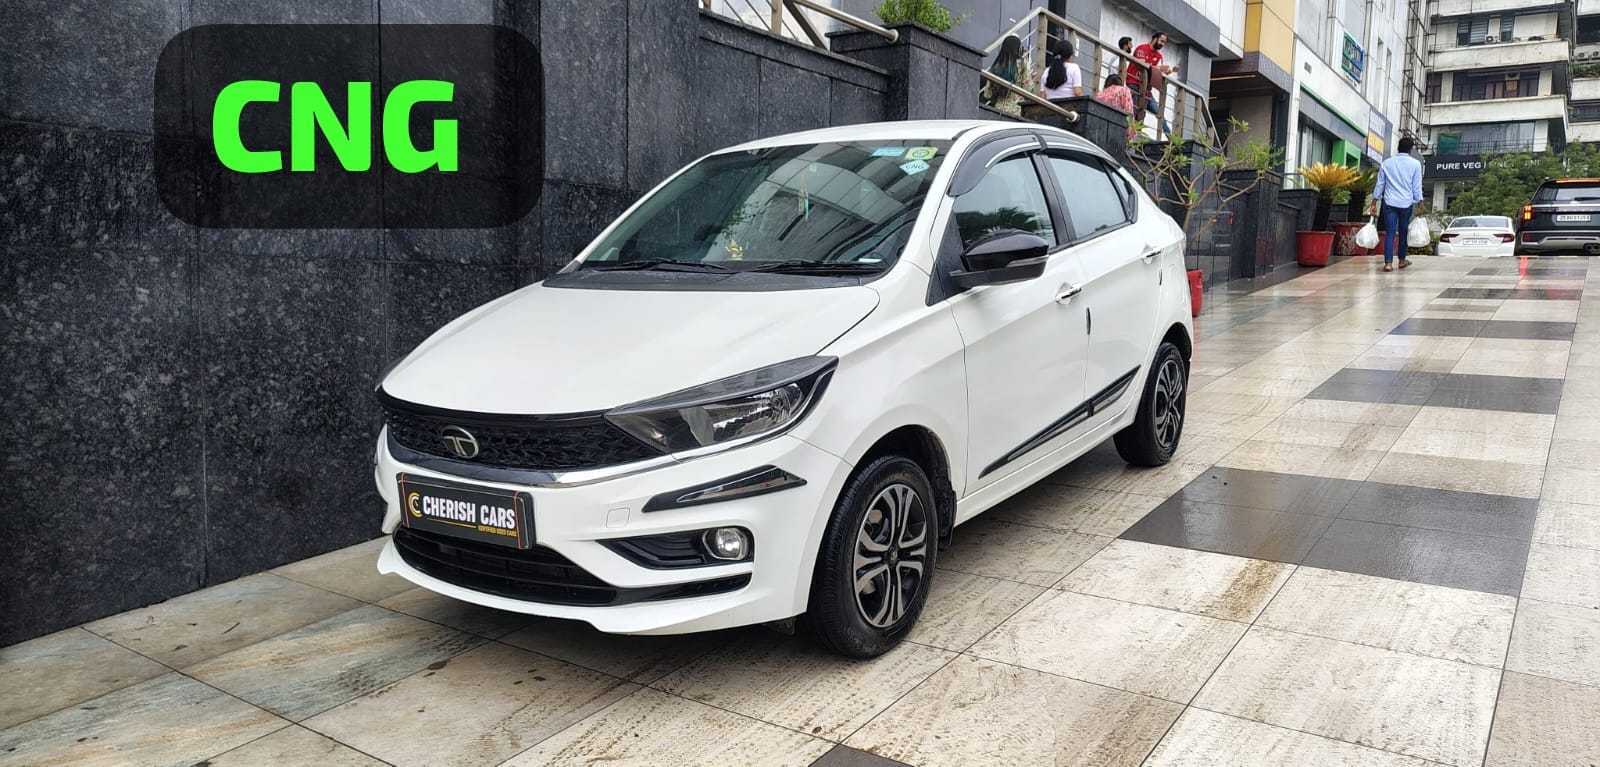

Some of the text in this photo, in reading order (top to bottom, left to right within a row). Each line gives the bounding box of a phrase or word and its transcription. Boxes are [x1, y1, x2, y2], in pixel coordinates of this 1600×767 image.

[1436, 162, 1461, 171] PURE
[1462, 161, 1482, 169] VEG
[422, 496, 516, 529] CHERISH CARS
